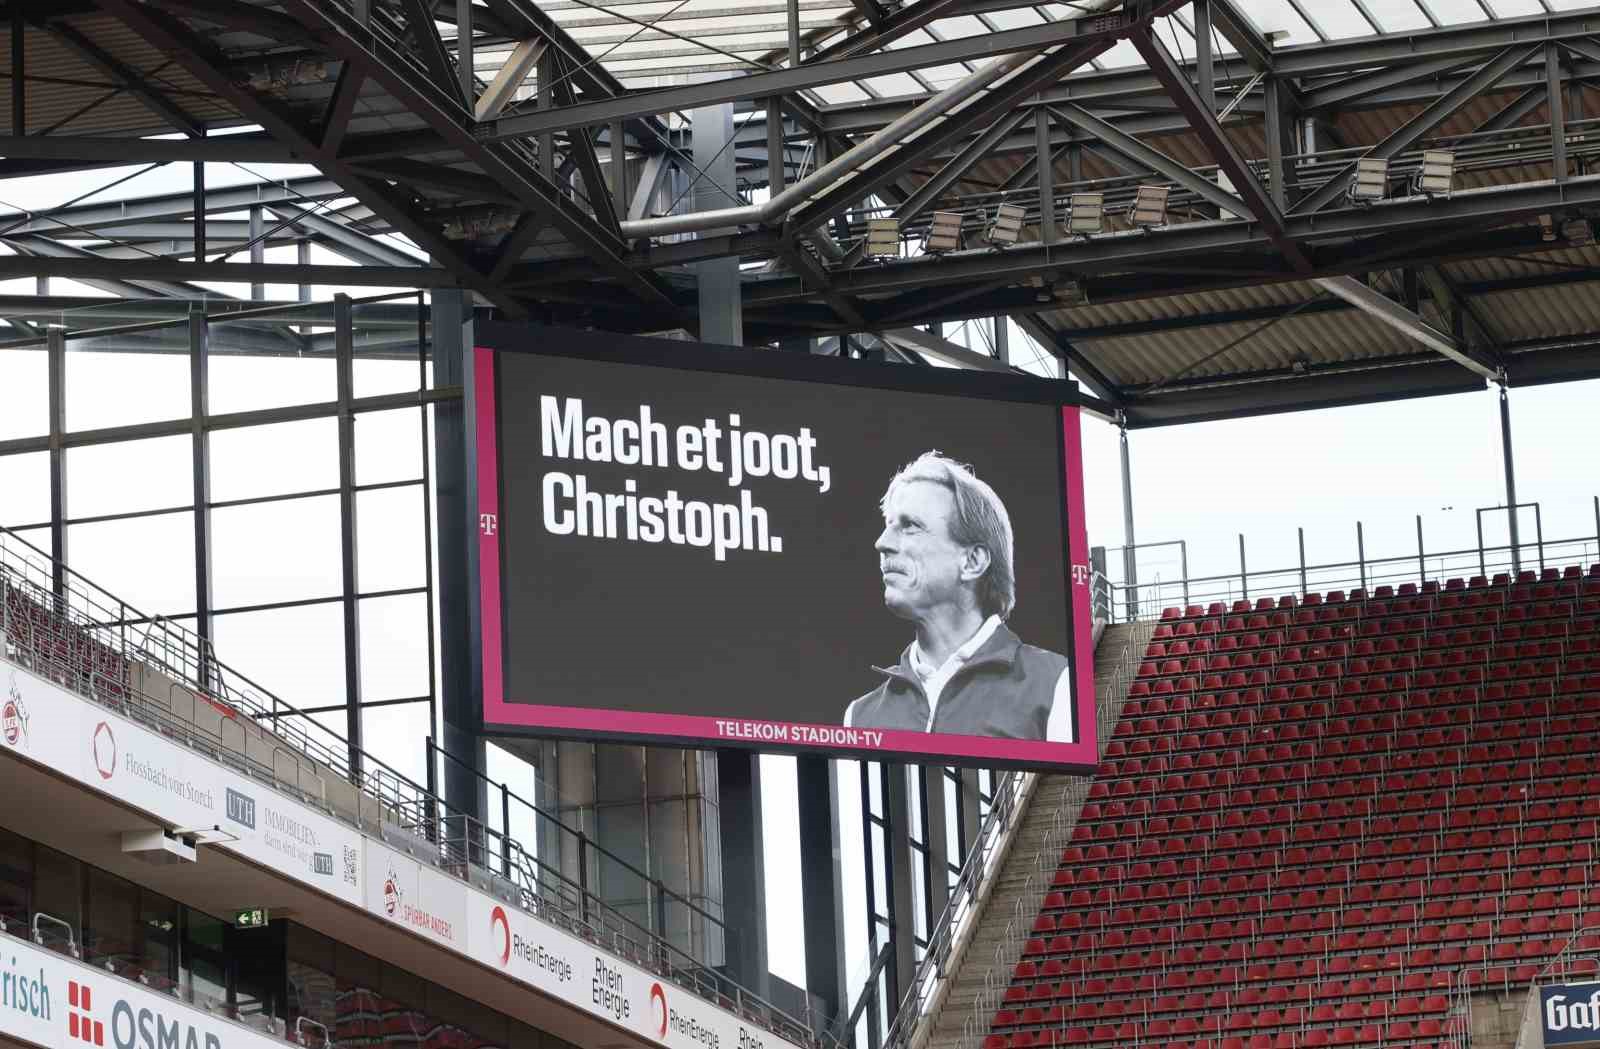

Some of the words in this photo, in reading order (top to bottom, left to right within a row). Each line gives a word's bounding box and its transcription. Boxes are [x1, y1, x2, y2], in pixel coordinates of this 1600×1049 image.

[540, 395, 669, 468] Mach
[676, 417, 724, 473] et
[728, 413, 831, 494] joot,
[542, 471, 783, 562] Christoph.
[716, 720, 788, 740] TELEKOM
[791, 726, 883, 747] STADION-TV
[513, 933, 572, 982] RheinEnergie
[595, 956, 623, 993] Rhein
[592, 977, 630, 1020] Energie
[669, 1007, 720, 1049] RheinEnergie
